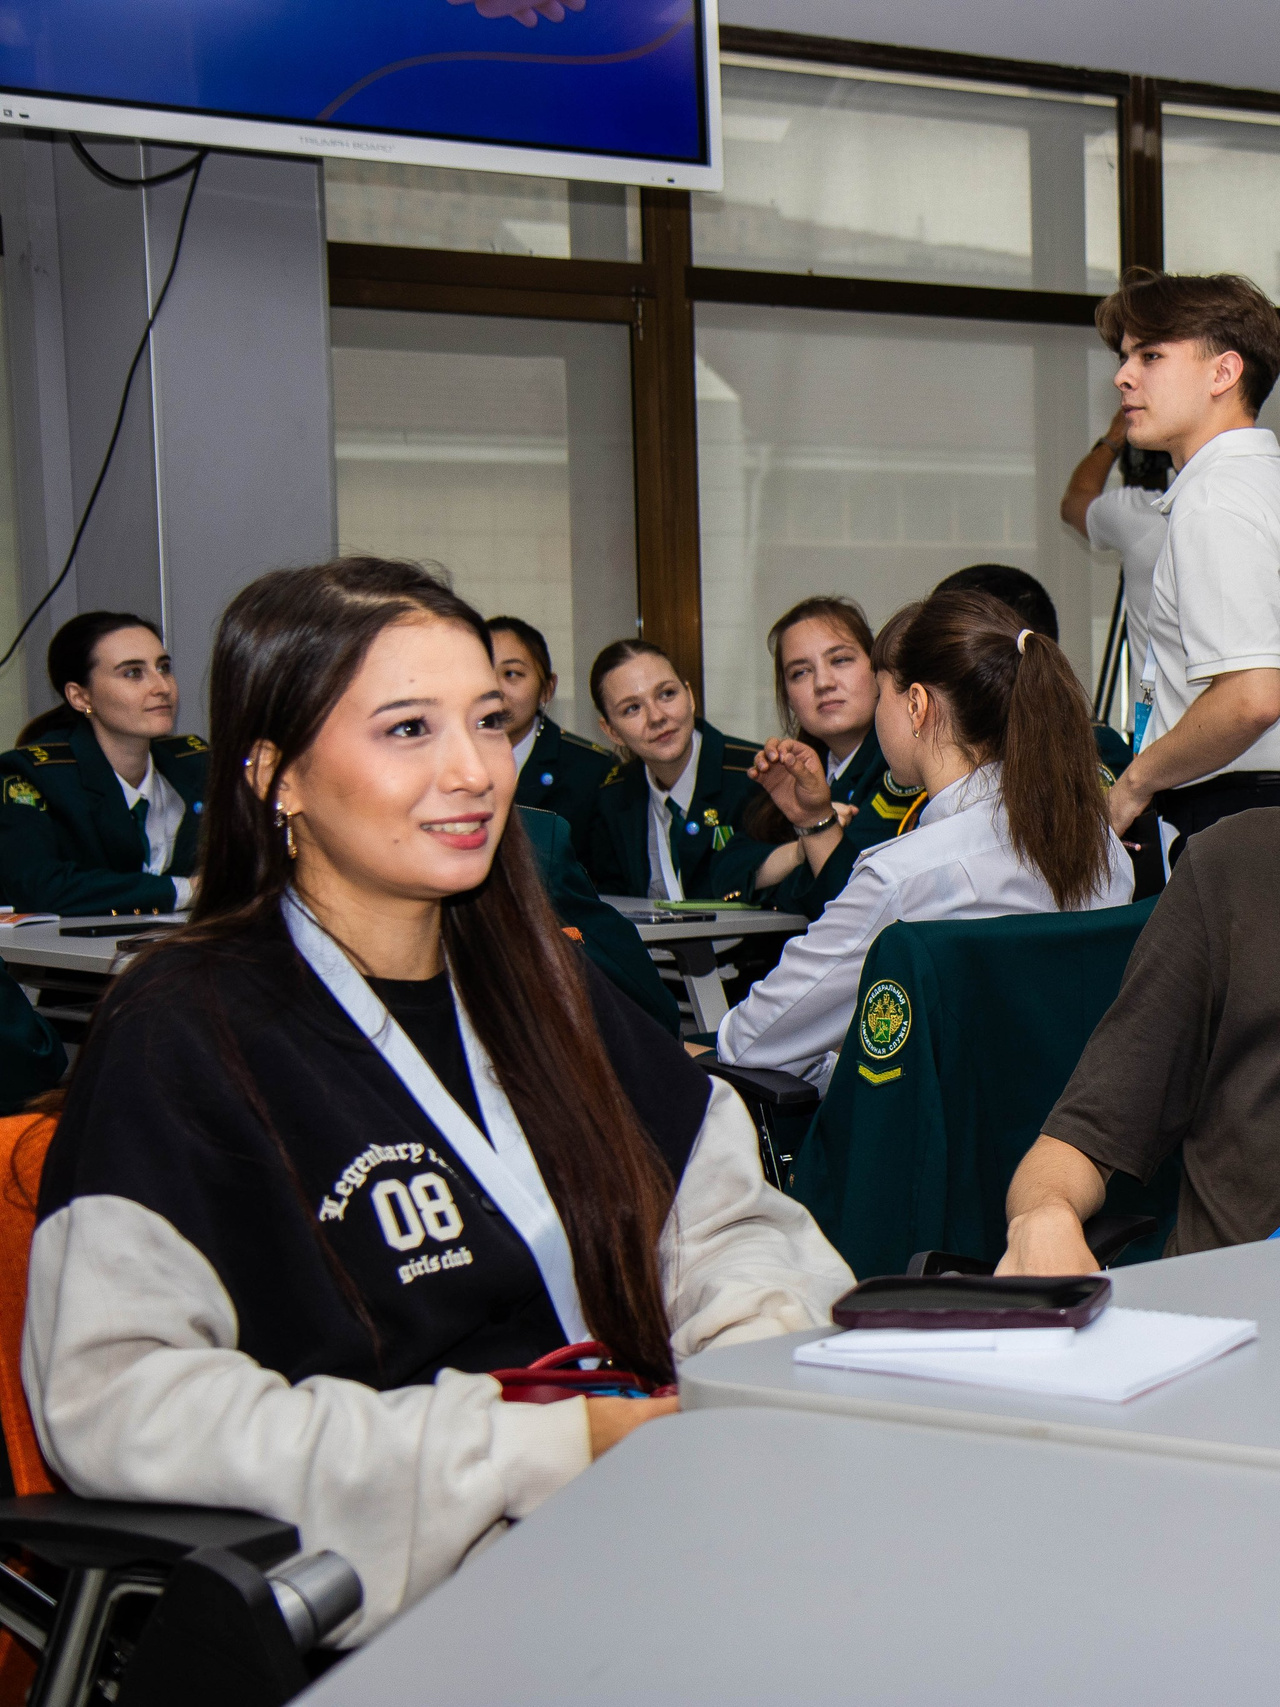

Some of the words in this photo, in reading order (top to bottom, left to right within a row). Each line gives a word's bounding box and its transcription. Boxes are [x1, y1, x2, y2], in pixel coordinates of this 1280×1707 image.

[319, 1143, 425, 1222] Legendary
[371, 1172, 464, 1251] 08
[398, 1254, 441, 1284] girls
[441, 1246, 473, 1269] club
